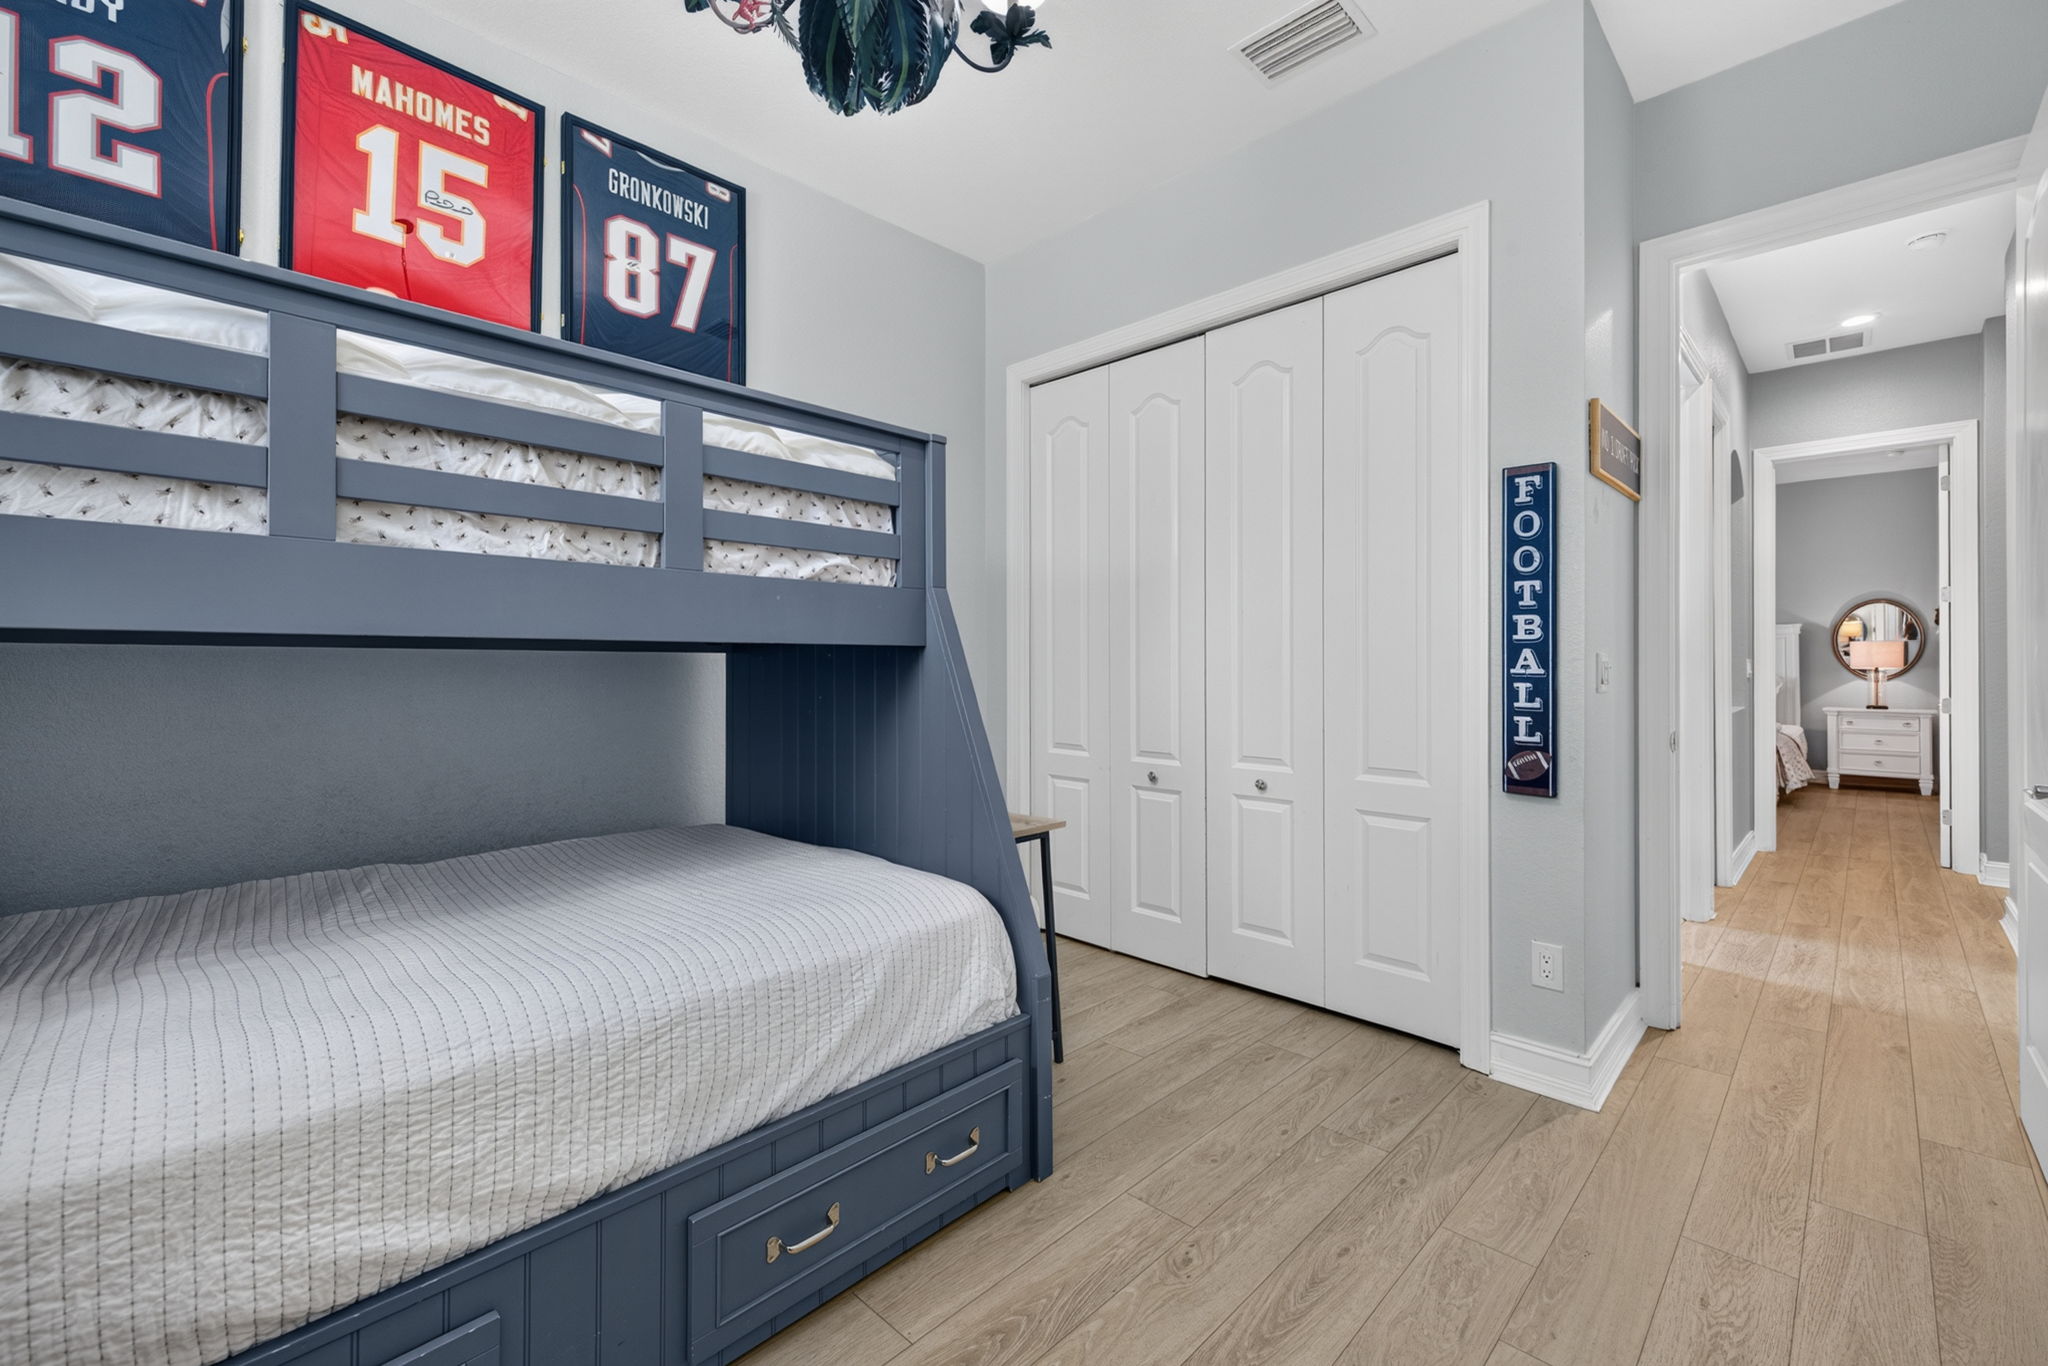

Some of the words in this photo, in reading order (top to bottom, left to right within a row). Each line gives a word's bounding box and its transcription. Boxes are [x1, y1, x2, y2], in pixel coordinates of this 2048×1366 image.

[352, 64, 490, 146] MAHOMES
[352, 124, 489, 268] 15
[608, 168, 709, 230] GRONKOWSKI
[603, 214, 718, 333] 87
[1510, 475, 1547, 746] FOOTBALL
